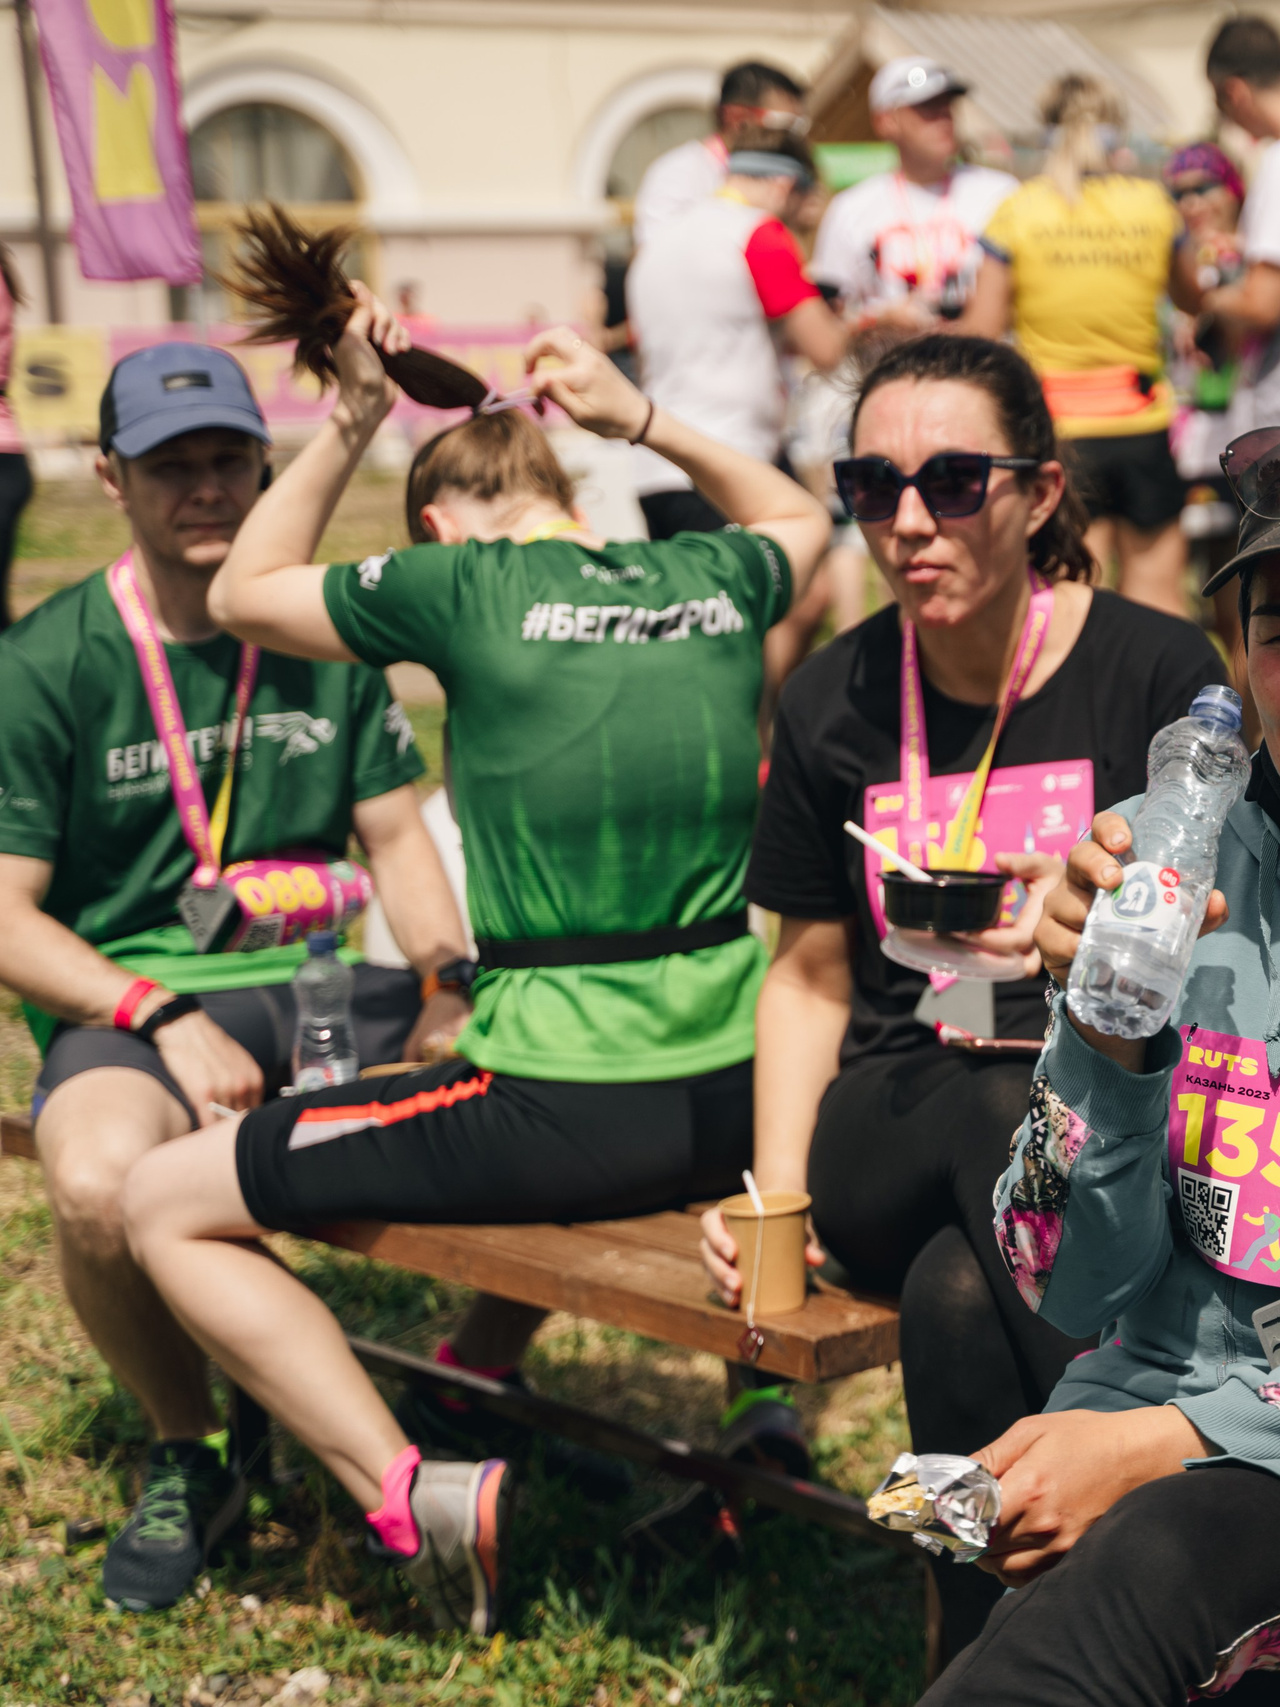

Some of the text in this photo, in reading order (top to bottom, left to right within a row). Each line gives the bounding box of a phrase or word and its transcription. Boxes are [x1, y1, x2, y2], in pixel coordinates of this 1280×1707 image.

[1188, 1045, 1258, 1076] RUTS
[1186, 1074, 1270, 1100] КАЗАНЬ 2023
